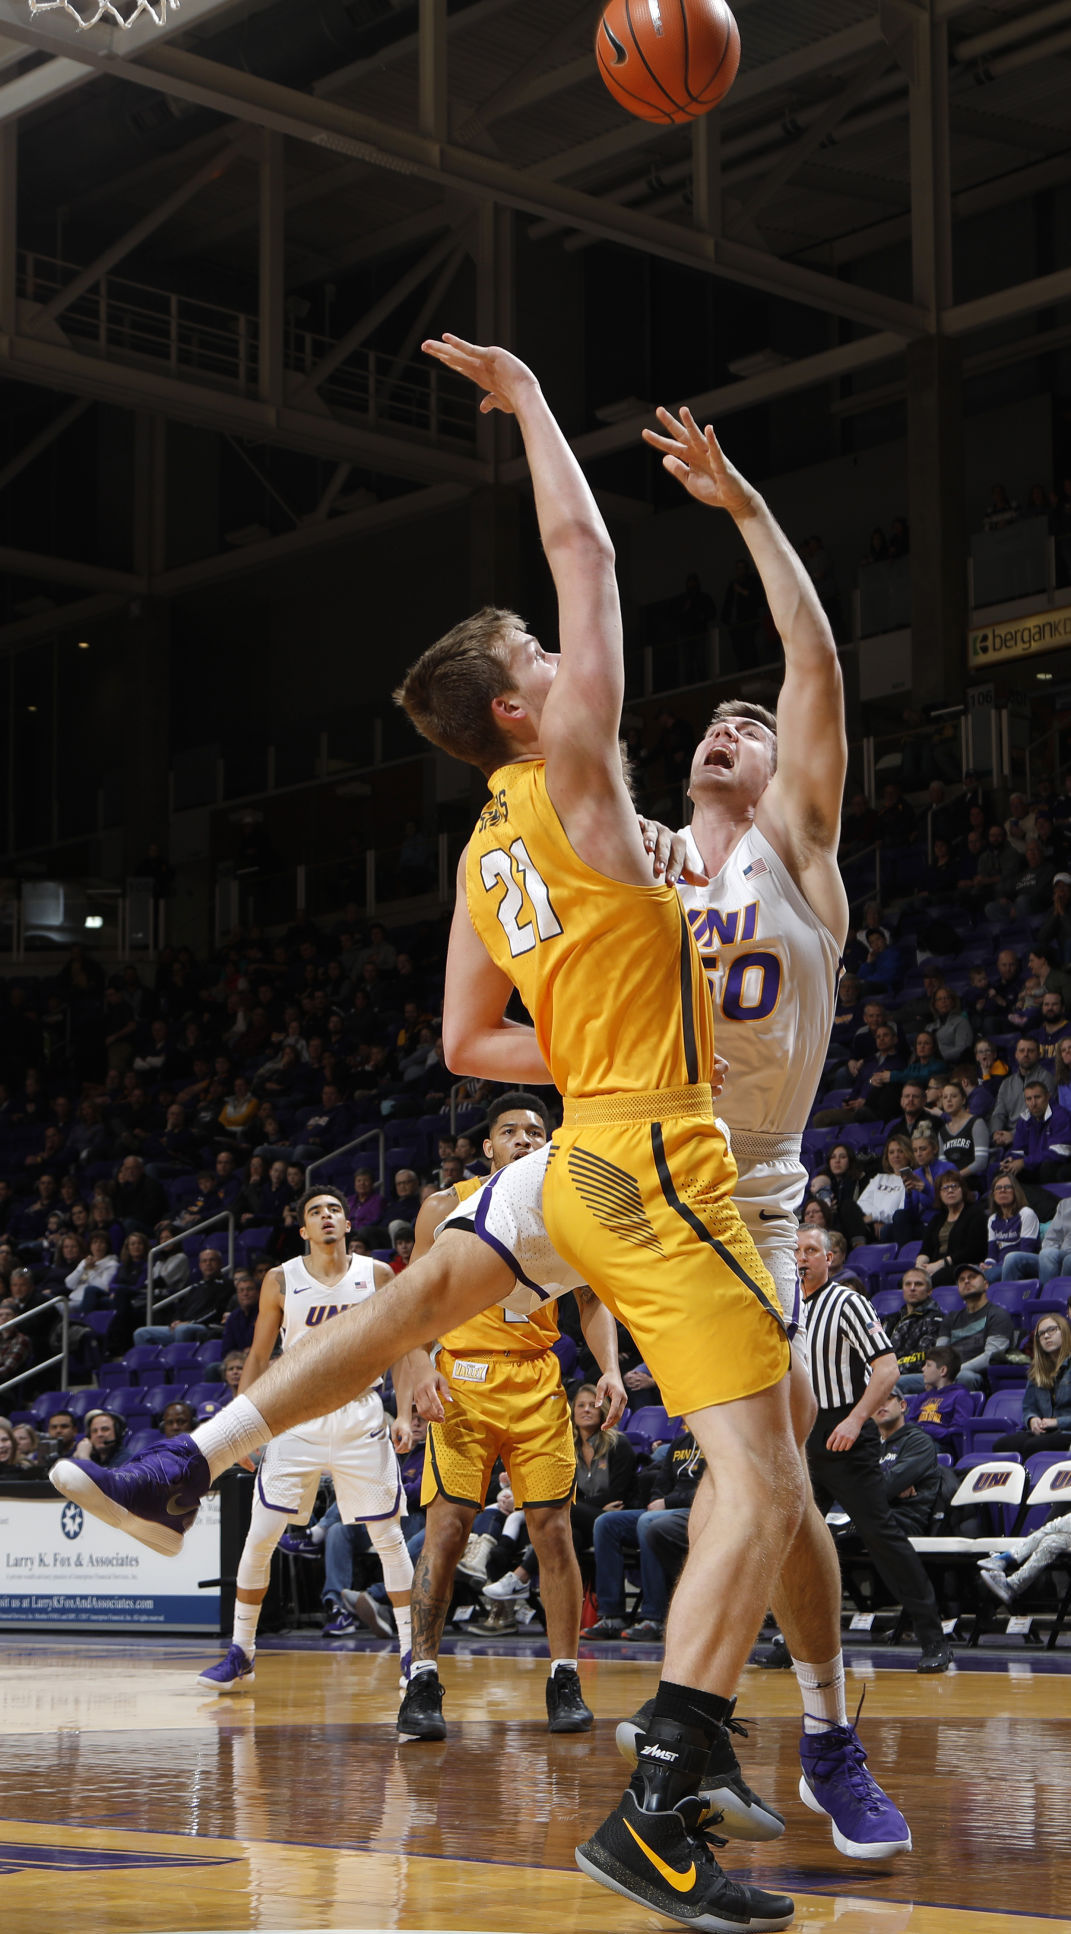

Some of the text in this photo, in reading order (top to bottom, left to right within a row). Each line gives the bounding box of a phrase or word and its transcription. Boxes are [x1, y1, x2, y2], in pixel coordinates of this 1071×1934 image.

[480, 836, 564, 958] 21
[687, 900, 760, 949] UNI
[972, 1471, 1013, 1493] UNI
[6, 1552, 140, 1571] Larry K. Fox & Associates
